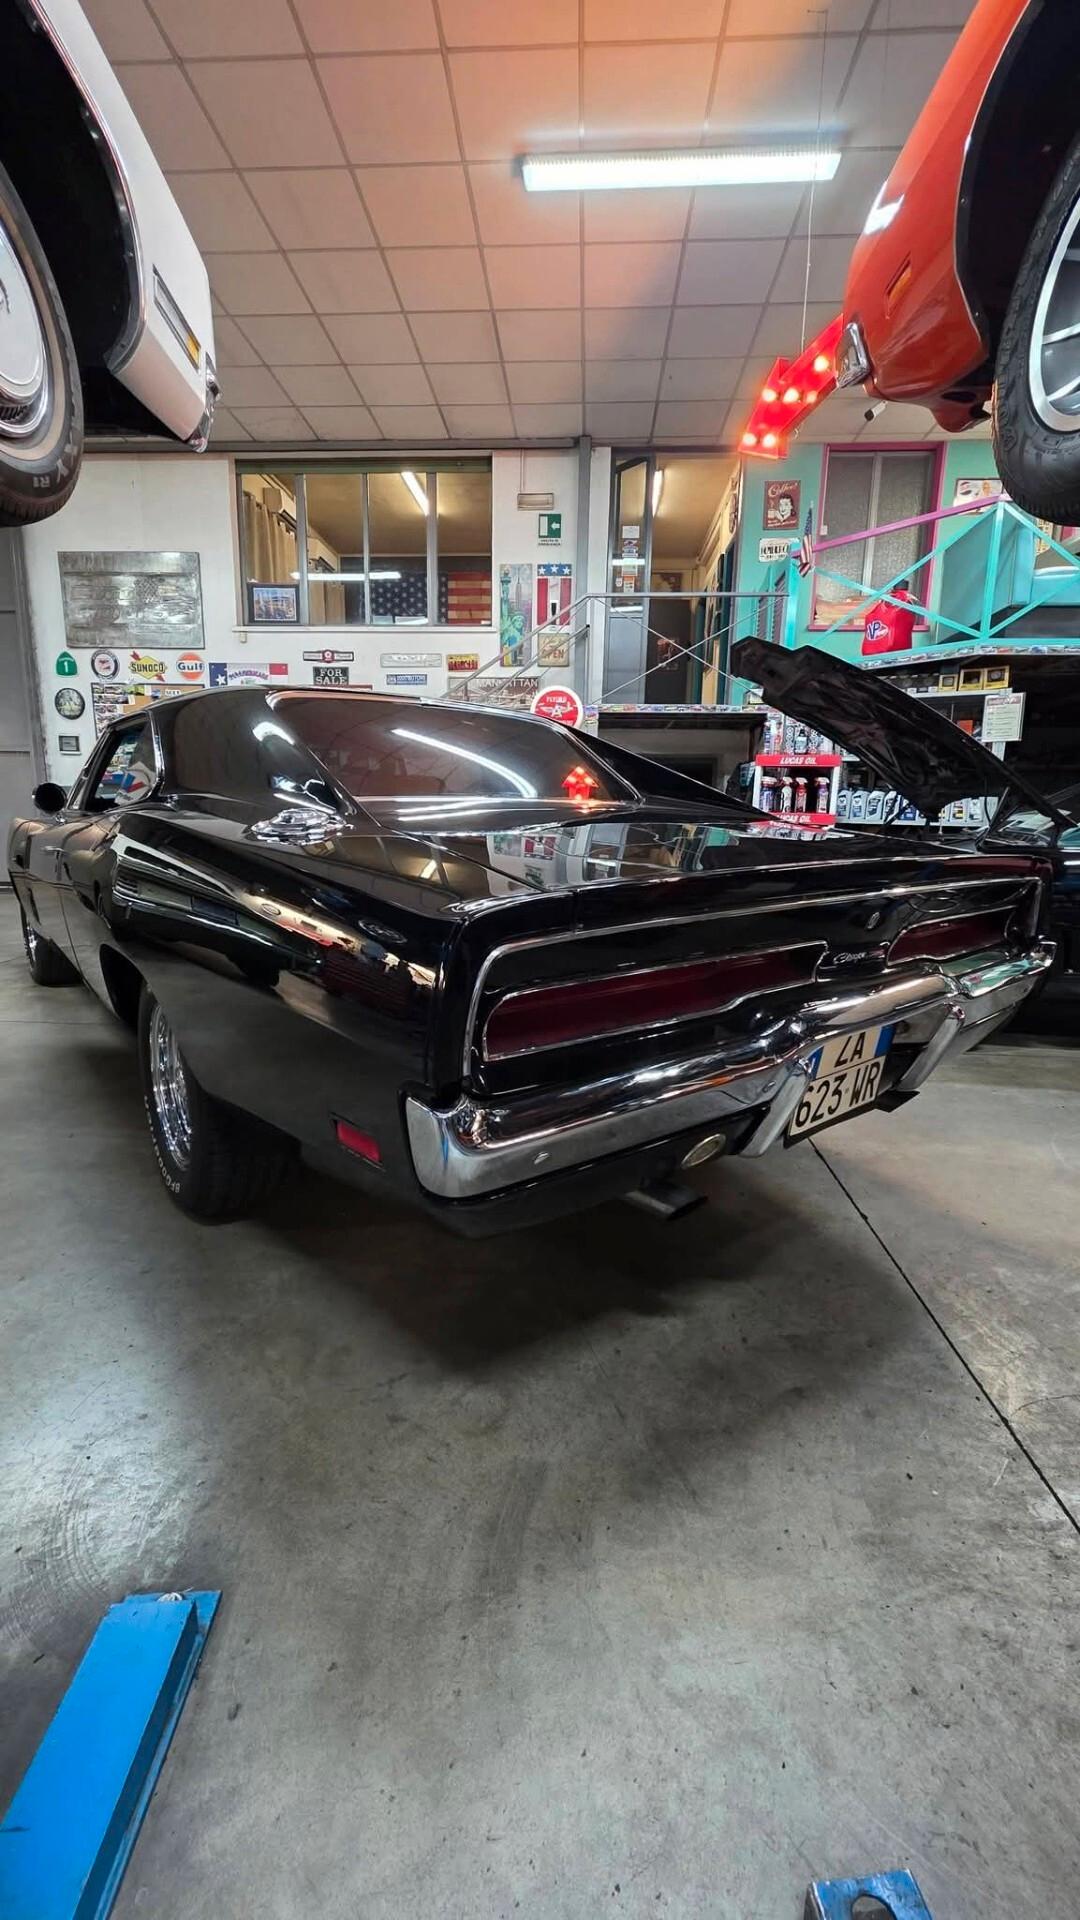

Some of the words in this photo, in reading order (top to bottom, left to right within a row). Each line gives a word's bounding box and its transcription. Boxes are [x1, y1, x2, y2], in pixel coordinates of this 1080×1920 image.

[63, 660, 69, 673] 1
[130, 662, 166, 675] SUNOCO
[177, 662, 204, 671] Gulf
[319, 668, 343, 677] FOR
[315, 676, 348, 686] SALE
[478, 678, 538, 688] MANATTAN
[780, 757, 804, 765] LUCAS
[804, 757, 817, 765] OIL
[799, 815, 811, 823] OIL
[796, 1076, 848, 1128] 623
[849, 1061, 881, 1108] WR
